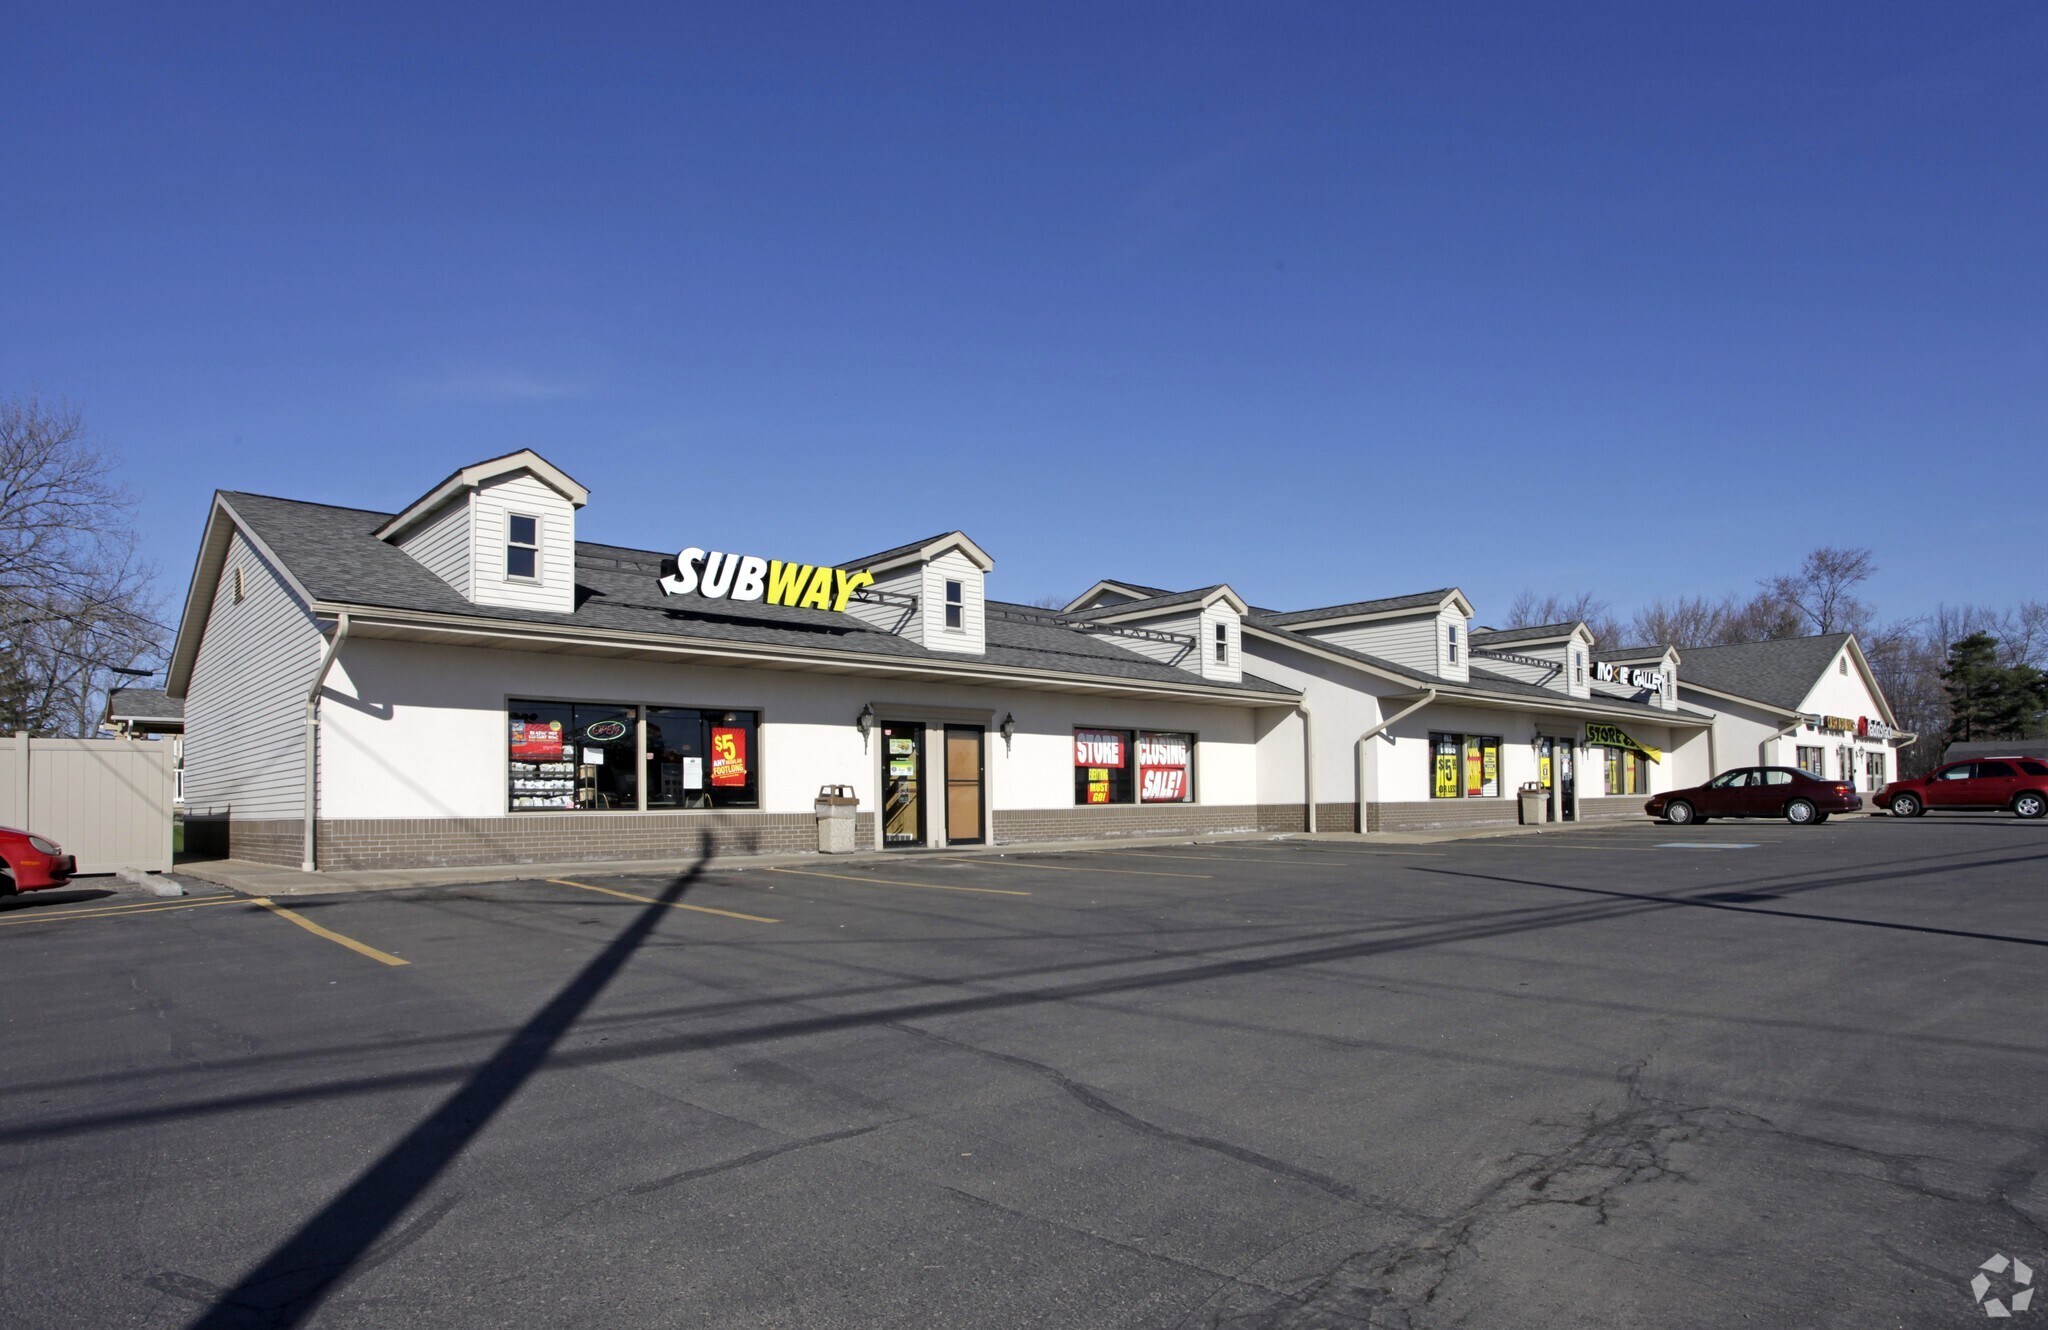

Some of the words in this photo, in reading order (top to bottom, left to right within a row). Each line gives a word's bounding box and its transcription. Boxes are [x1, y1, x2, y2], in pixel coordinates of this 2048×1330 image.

[656, 547, 875, 613] SUBWAY
[1632, 669, 1666, 694] GALLERY
[591, 723, 622, 736] OPEN
[1588, 725, 1622, 744] STORE
[714, 734, 736, 760] $5
[1077, 733, 1119, 764] STORE
[1139, 737, 1186, 764] CLOSING
[713, 759, 726, 767] ANY
[713, 763, 744, 776] FOOTLONG
[1089, 782, 1108, 793] MUST
[1142, 770, 1183, 799] SALE!
[1092, 792, 1107, 802] GO!
